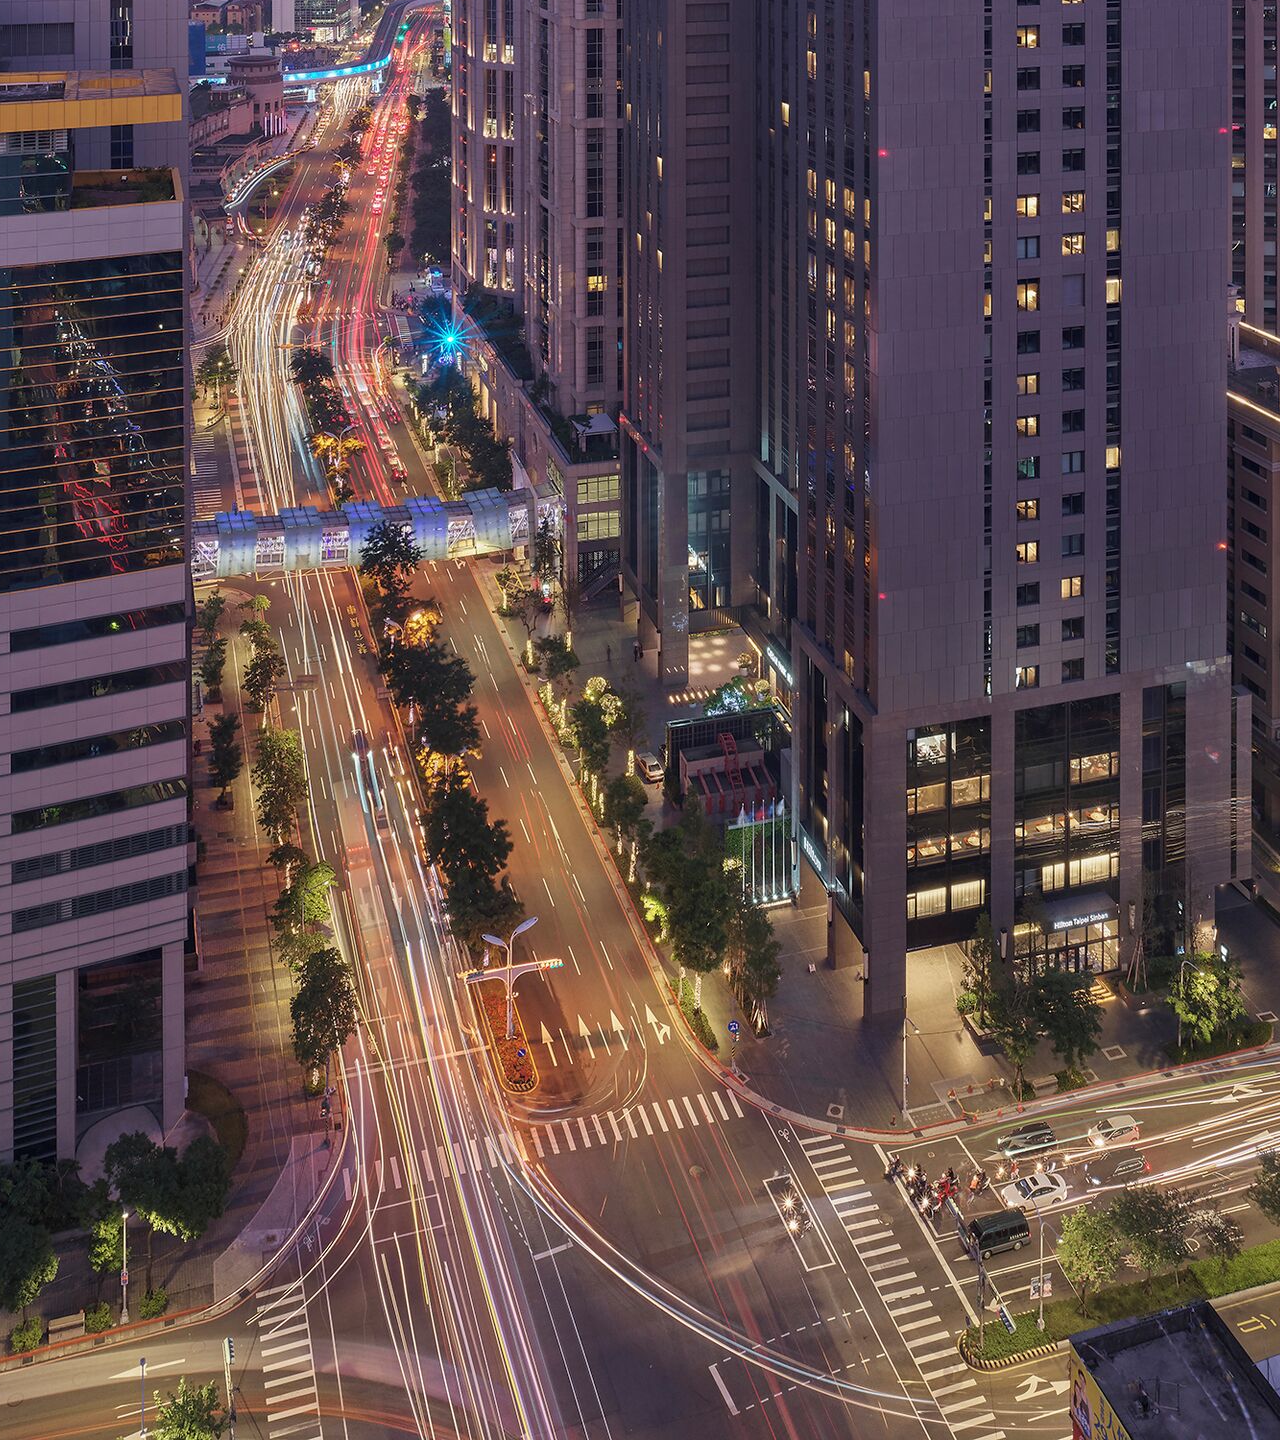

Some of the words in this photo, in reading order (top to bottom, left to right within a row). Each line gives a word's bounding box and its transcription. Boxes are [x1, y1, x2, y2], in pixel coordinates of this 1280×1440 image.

[803, 836, 822, 872] Hilton
[1053, 920, 1073, 930] Hilton
[1073, 915, 1090, 925] Taipei
[1090, 912, 1109, 922] Sinban
